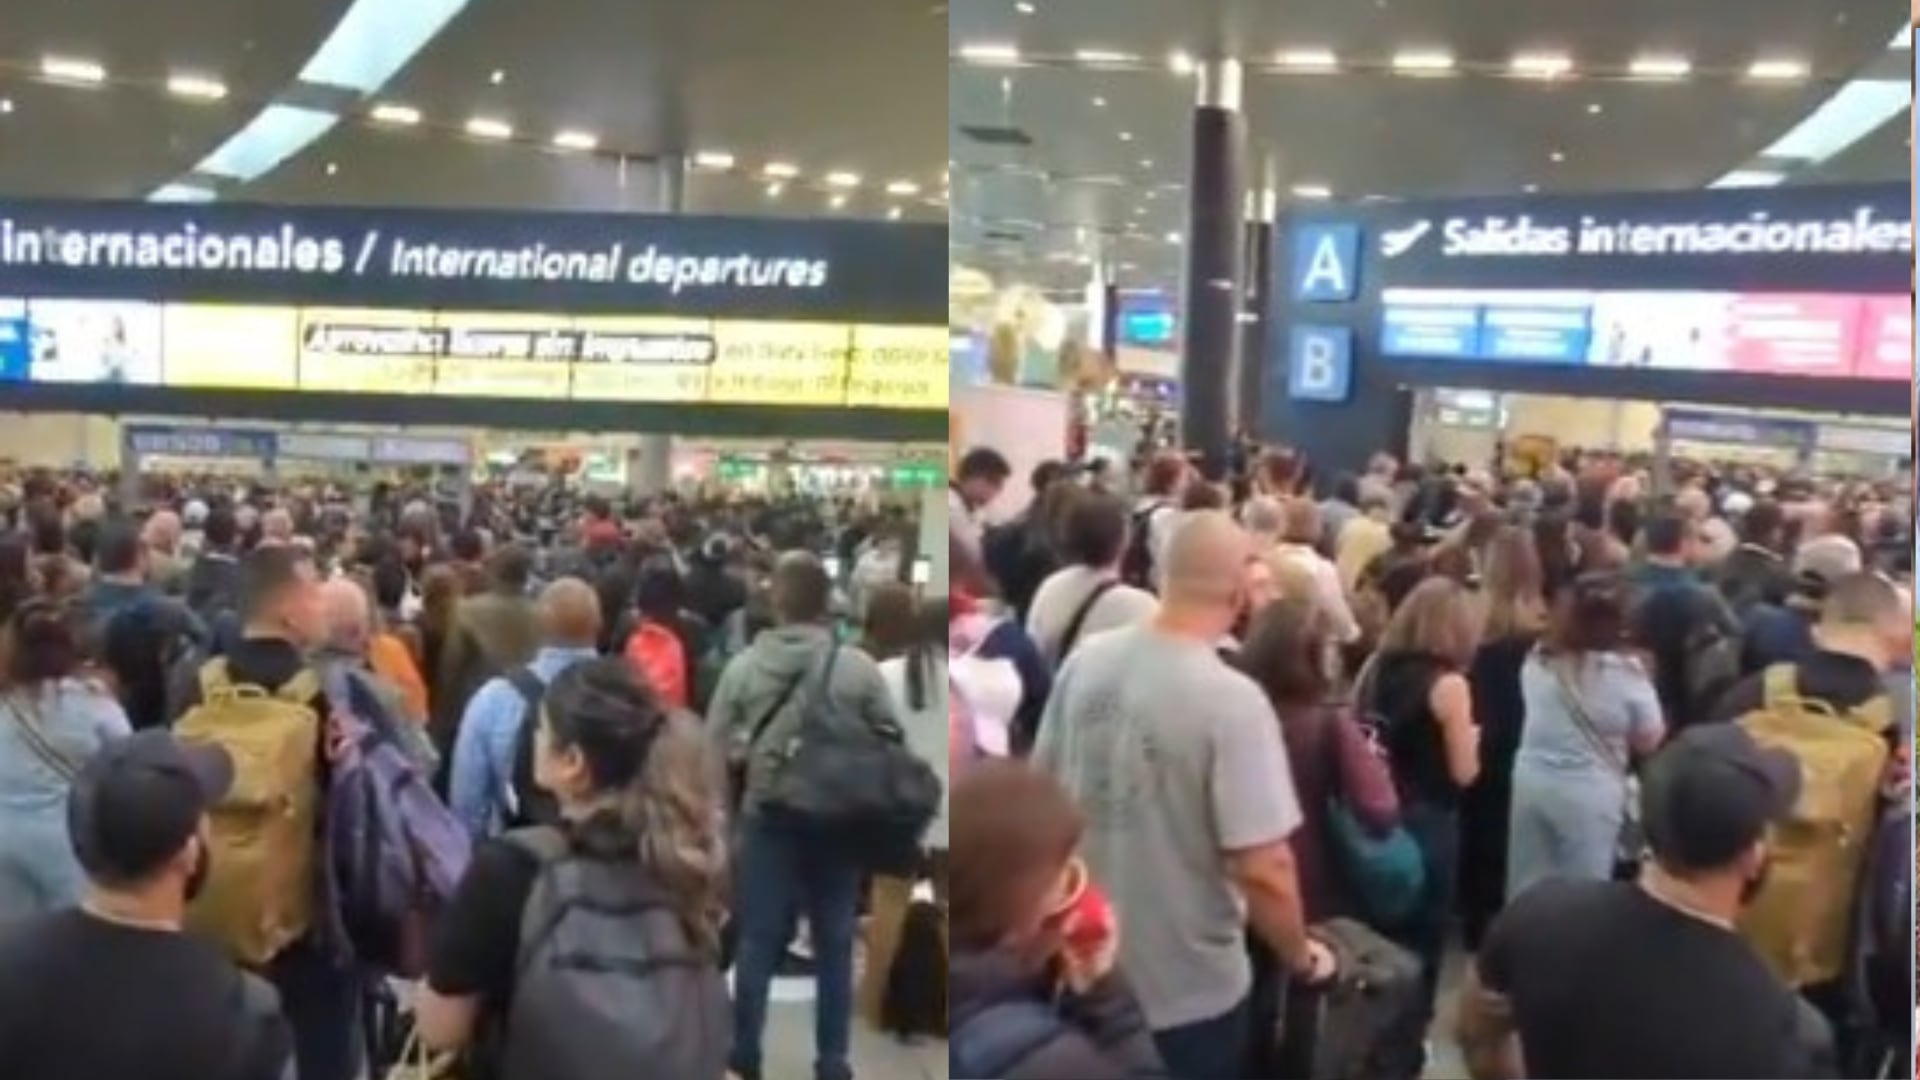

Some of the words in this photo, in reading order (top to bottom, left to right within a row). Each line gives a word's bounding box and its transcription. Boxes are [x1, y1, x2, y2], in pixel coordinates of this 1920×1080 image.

[1, 218, 344, 273] internacionales
[354, 231, 378, 274] /
[390, 238, 621, 281] International
[626, 244, 828, 294] departures
[1441, 215, 1571, 256] Salidas
[1577, 204, 1912, 254] internacionales
[1302, 234, 1345, 291] A
[1303, 337, 1336, 388] B
